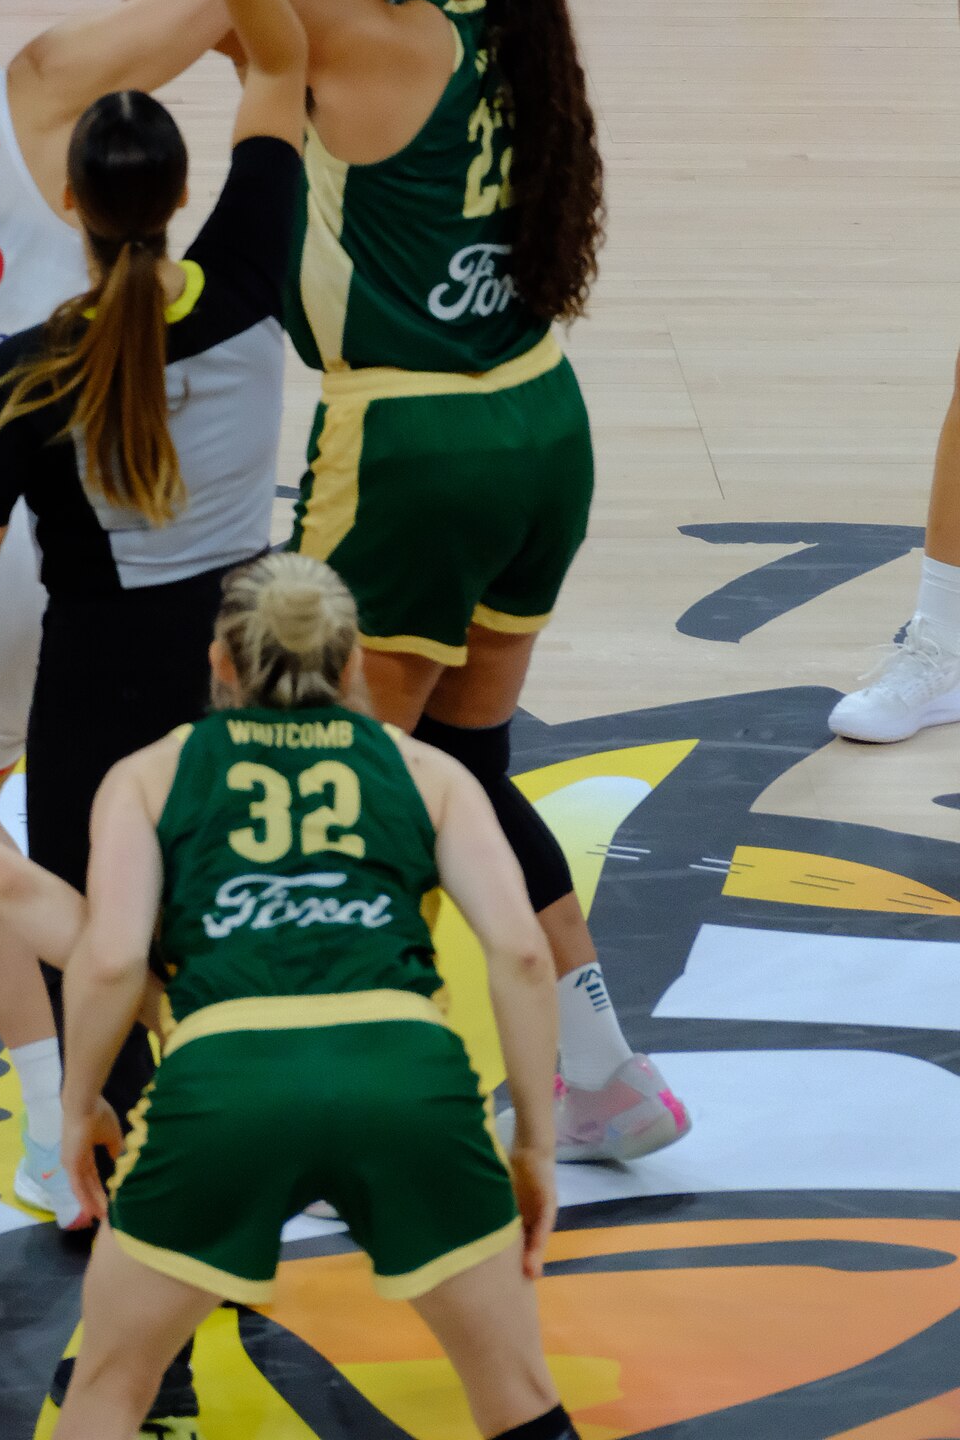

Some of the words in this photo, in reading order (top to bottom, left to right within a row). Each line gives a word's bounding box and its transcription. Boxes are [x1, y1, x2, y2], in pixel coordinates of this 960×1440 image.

[426, 243, 524, 322] For
[226, 759, 367, 864] 32
[201, 872, 394, 939] Ford
